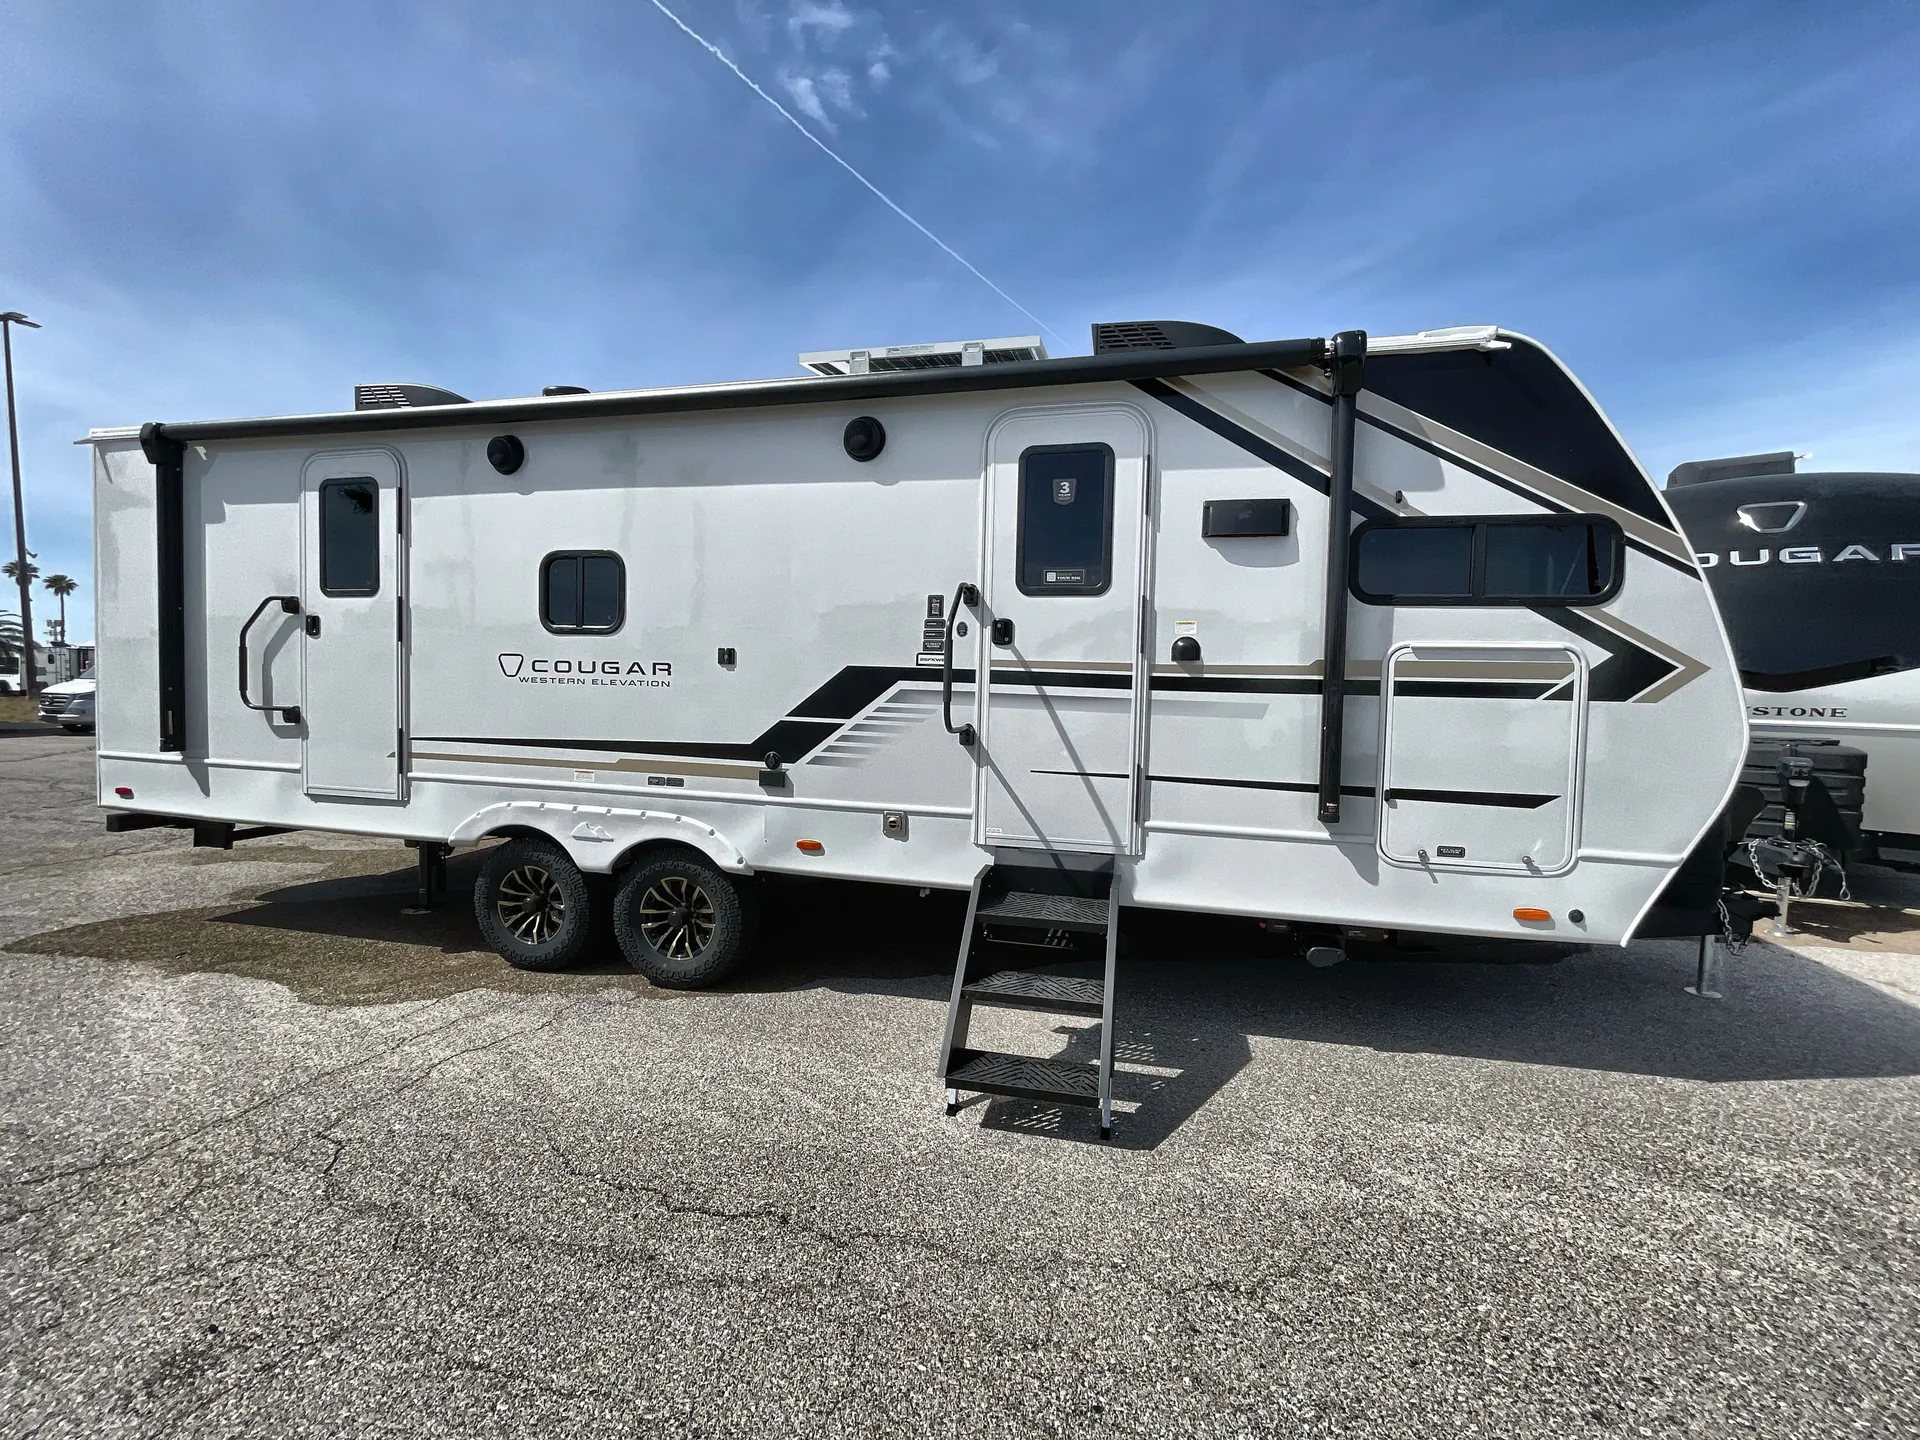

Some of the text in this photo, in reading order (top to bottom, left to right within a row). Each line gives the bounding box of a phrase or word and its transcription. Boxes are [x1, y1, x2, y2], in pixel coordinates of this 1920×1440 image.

[1059, 481, 1070, 494] 3
[1697, 544, 1920, 568] OUGAR
[531, 659, 672, 676] COUGAR
[518, 676, 671, 687] WESTERN ELEVATION
[1746, 706, 1848, 717] STONE
